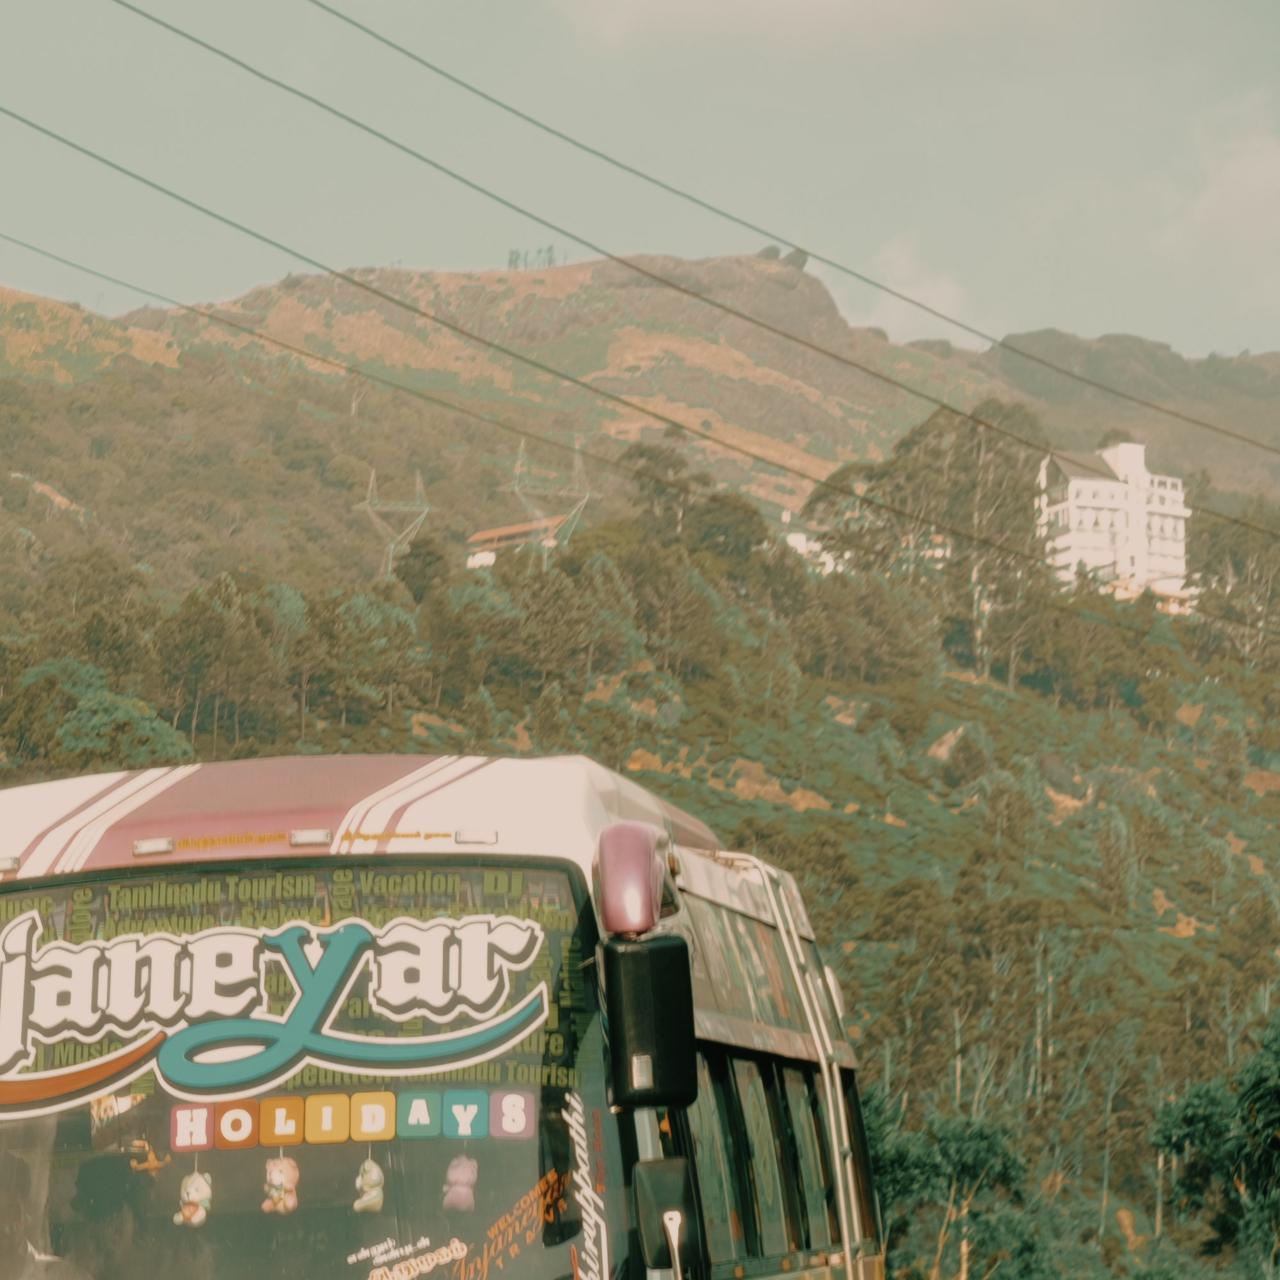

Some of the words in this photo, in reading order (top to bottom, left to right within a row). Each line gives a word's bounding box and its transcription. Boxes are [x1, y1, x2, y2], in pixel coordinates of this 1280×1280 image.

[225, 871, 316, 902] Tourism
[358, 870, 461, 896] Vacation
[175, 1092, 528, 1147] HOLIDAYS
